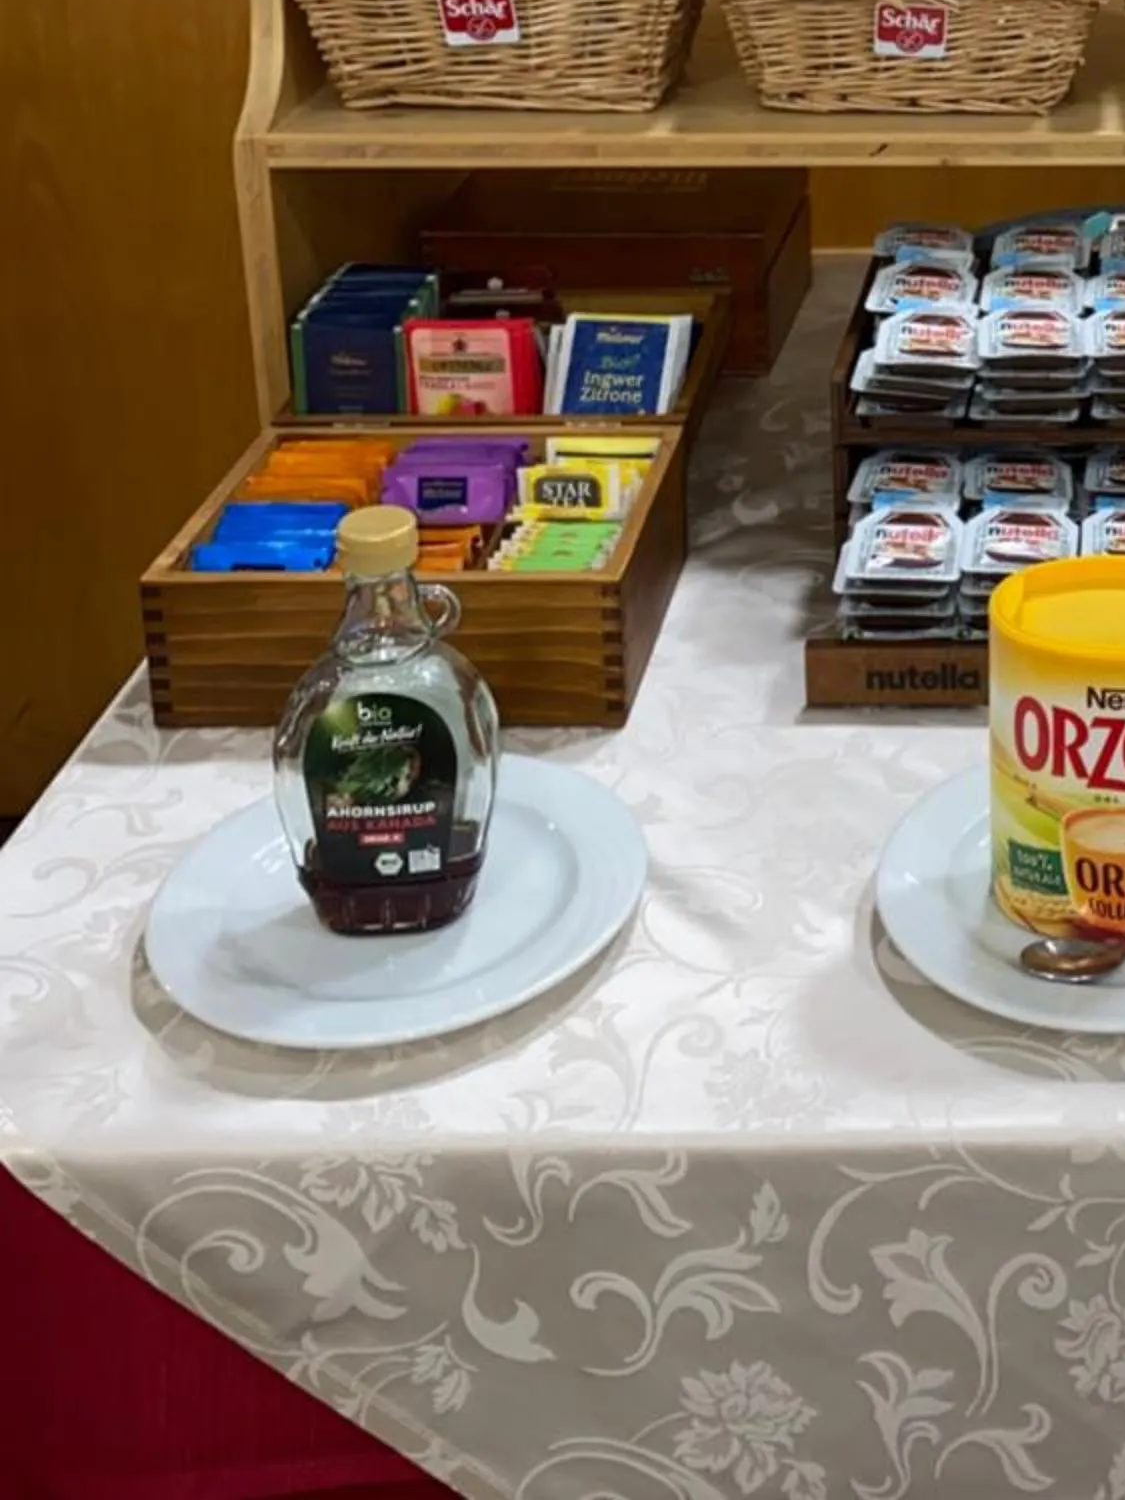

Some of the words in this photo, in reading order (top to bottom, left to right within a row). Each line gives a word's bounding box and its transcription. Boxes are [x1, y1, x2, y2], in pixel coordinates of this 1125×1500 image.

[880, 6, 942, 35] Schär
[583, 370, 645, 389] Ingwer
[581, 386, 643, 404] Zitrone
[880, 464, 948, 479] nutella
[541, 481, 591, 498] STAR
[988, 526, 1059, 541] nutella
[865, 663, 980, 691] nutella
[357, 701, 391, 722] bio
[327, 802, 436, 818] AHORNSIRUP
